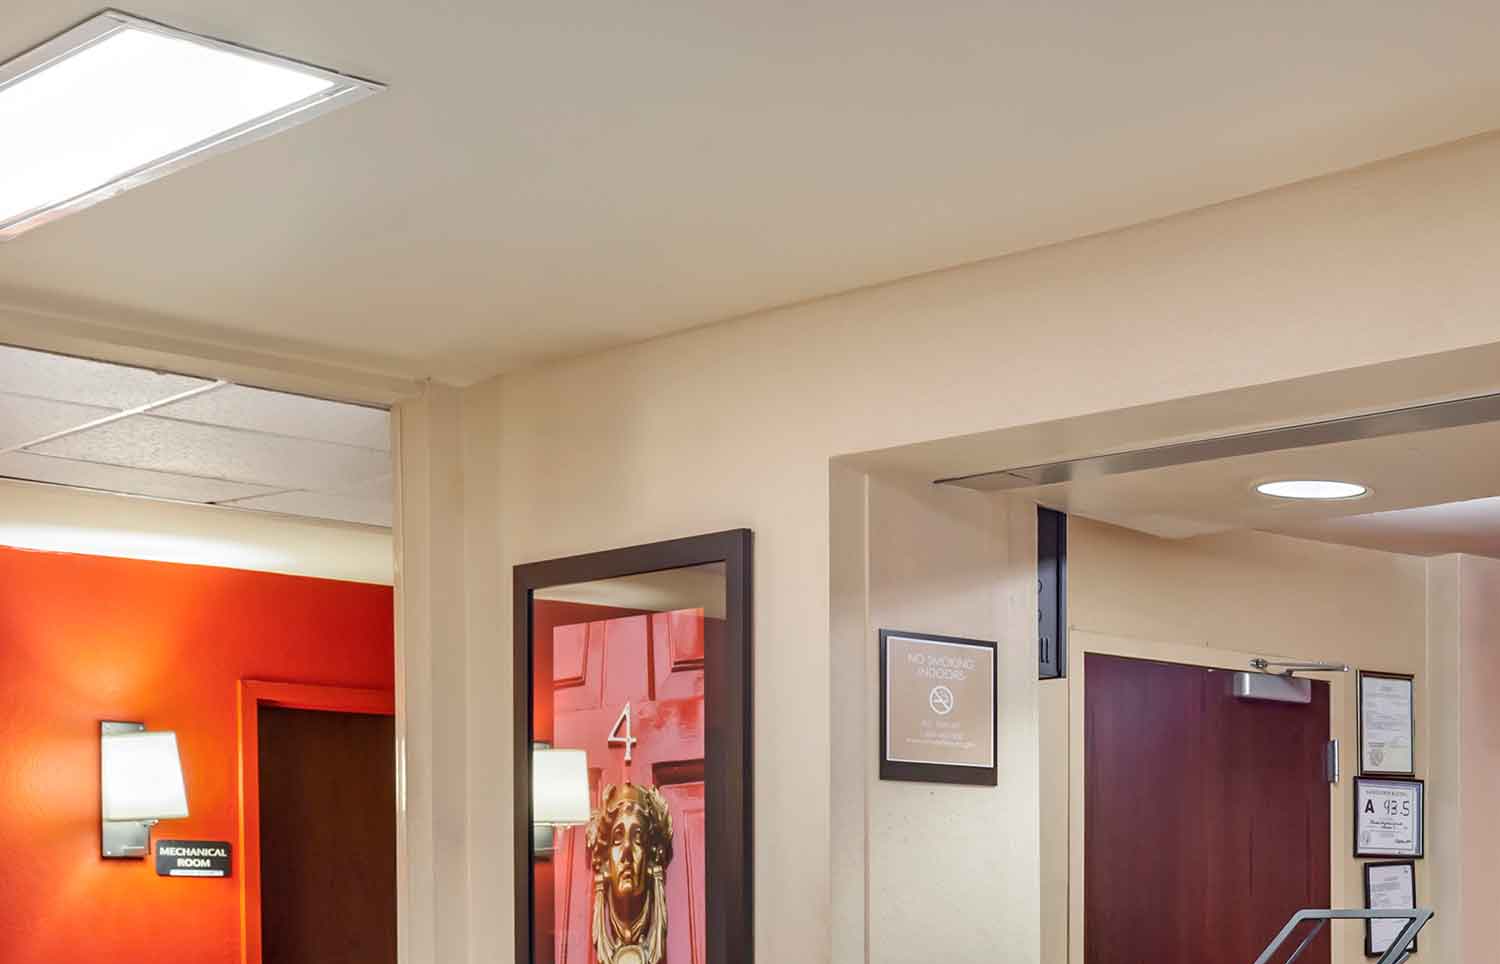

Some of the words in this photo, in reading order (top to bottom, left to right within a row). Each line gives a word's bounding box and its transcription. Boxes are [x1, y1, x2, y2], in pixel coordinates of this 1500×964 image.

[607, 701, 638, 761] 4
[1364, 799, 1375, 814] A
[159, 847, 227, 857] MECHANICAL
[176, 858, 211, 868] ROOM
